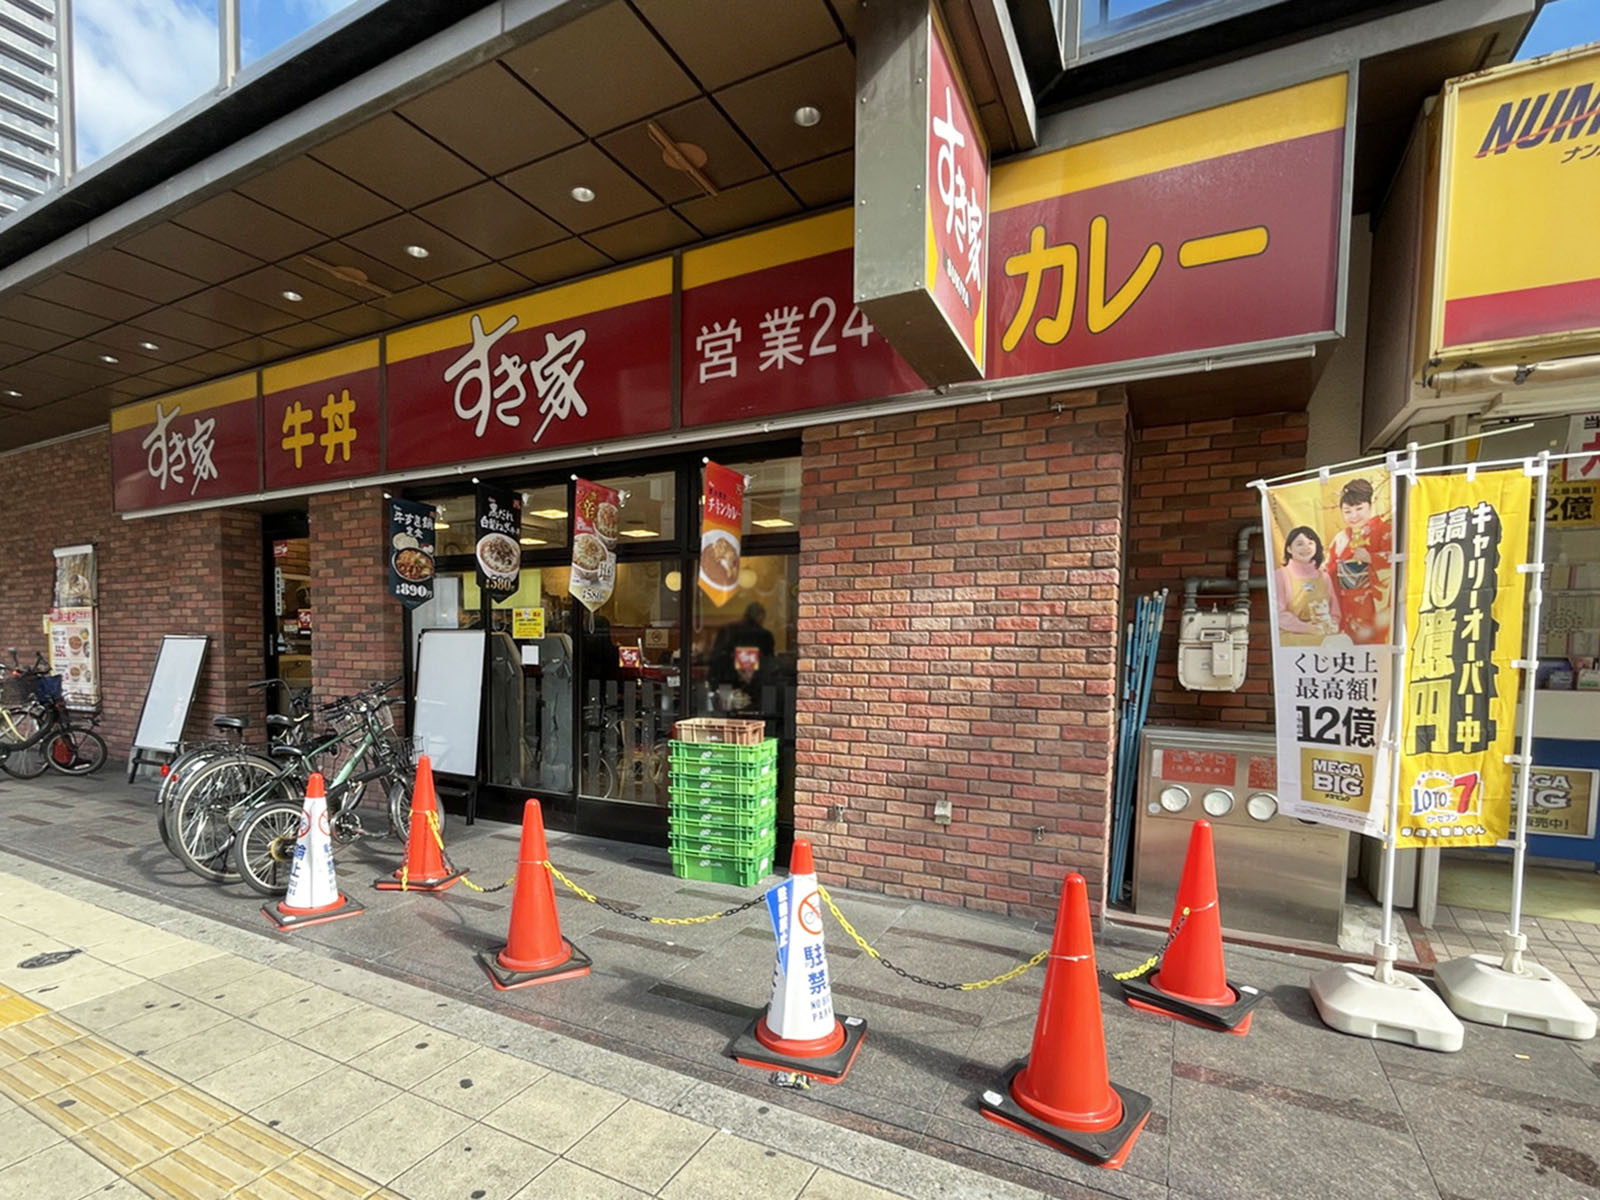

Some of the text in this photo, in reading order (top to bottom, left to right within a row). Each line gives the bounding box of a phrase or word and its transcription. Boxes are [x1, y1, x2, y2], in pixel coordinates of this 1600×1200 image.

[932, 86, 982, 292] すき家
[1001, 214, 1270, 353] カレー
[443, 313, 589, 444] すき家
[142, 402, 219, 496] すき家
[281, 388, 358, 470] 牛丼
[1456, 501, 1492, 754] キャリーオーバー中
[1294, 651, 1379, 674] くじ史上
[1296, 677, 1379, 702] 最高額!
[1296, 705, 1376, 748] 12億
[1312, 759, 1363, 777] MEGA
[1312, 774, 1363, 797] BIG
[1412, 788, 1448, 814] LOTO
[1453, 772, 1478, 814] 7
